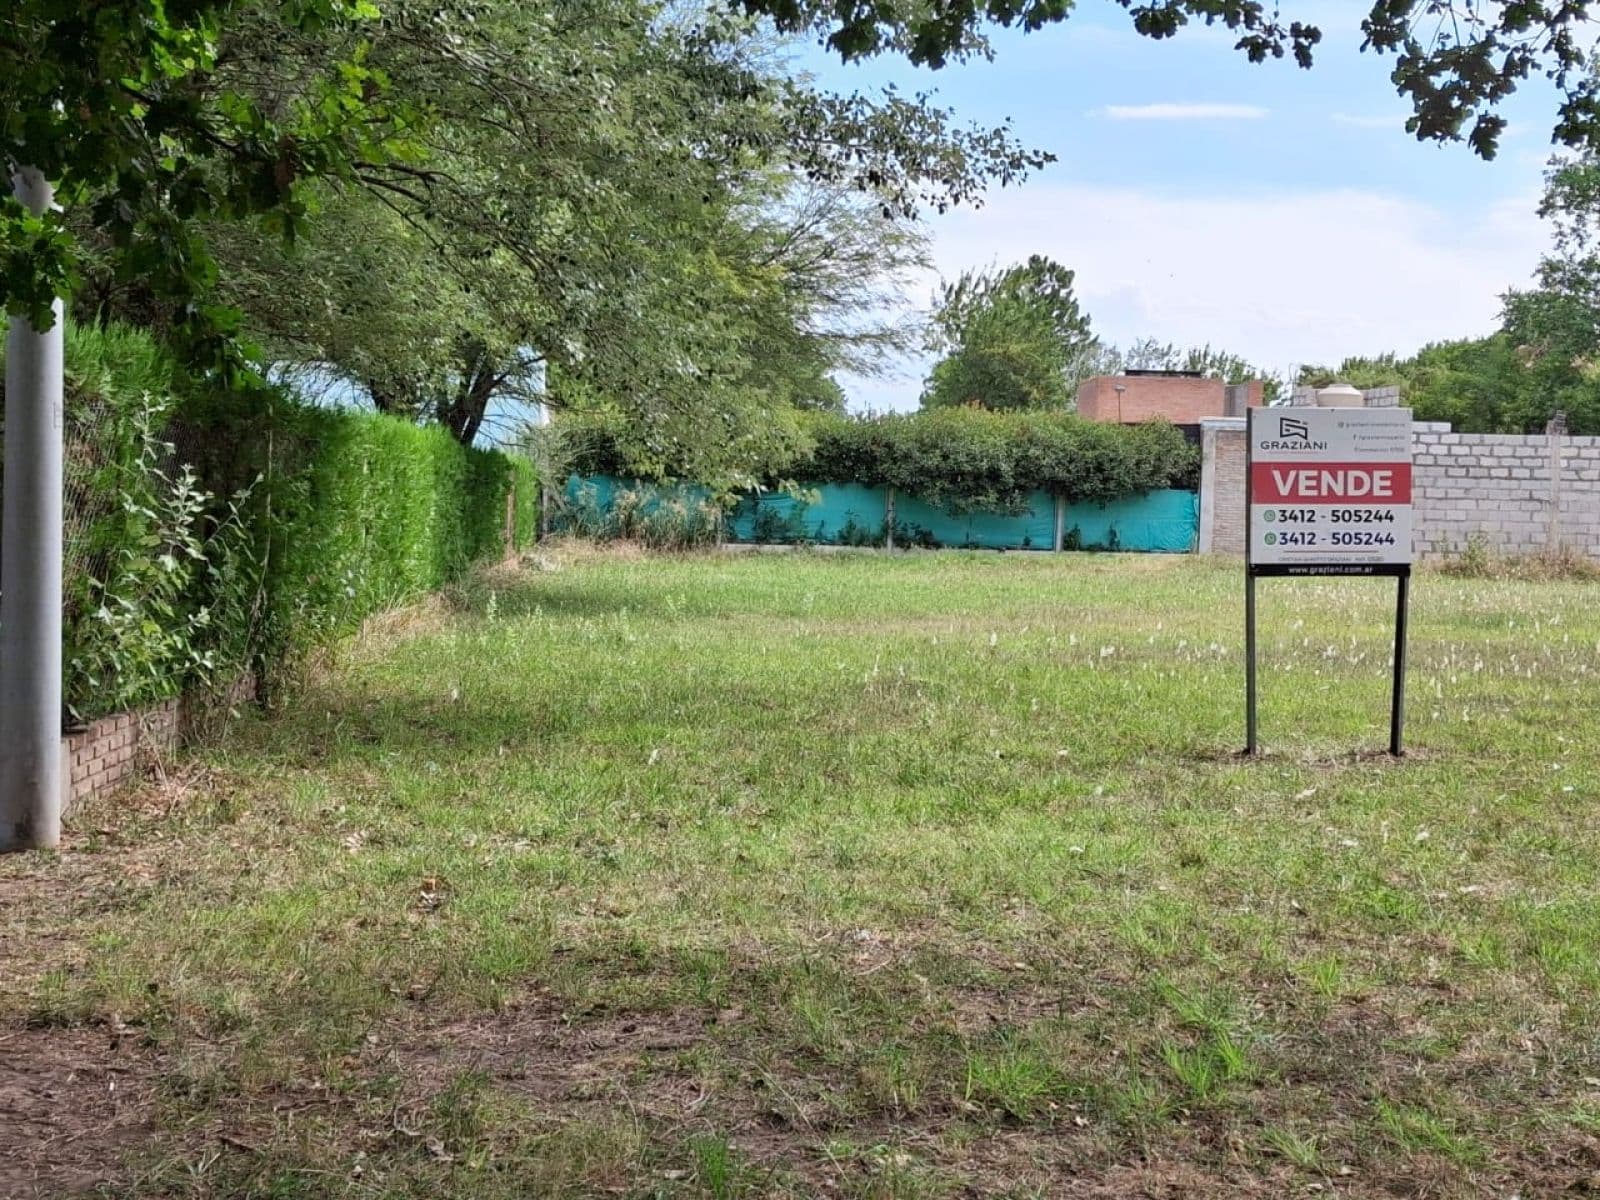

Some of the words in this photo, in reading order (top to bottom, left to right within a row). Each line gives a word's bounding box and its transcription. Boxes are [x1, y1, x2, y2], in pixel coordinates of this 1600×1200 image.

[1260, 441, 1328, 450] GRAZIANI
[1272, 469, 1393, 496] VENDE
[1278, 509, 1316, 523] 3412
[1330, 509, 1395, 523] 505244
[1279, 532, 1317, 545] 3412
[1331, 532, 1395, 545] 505244
[1288, 566, 1373, 575] www.graziani.com.ar
